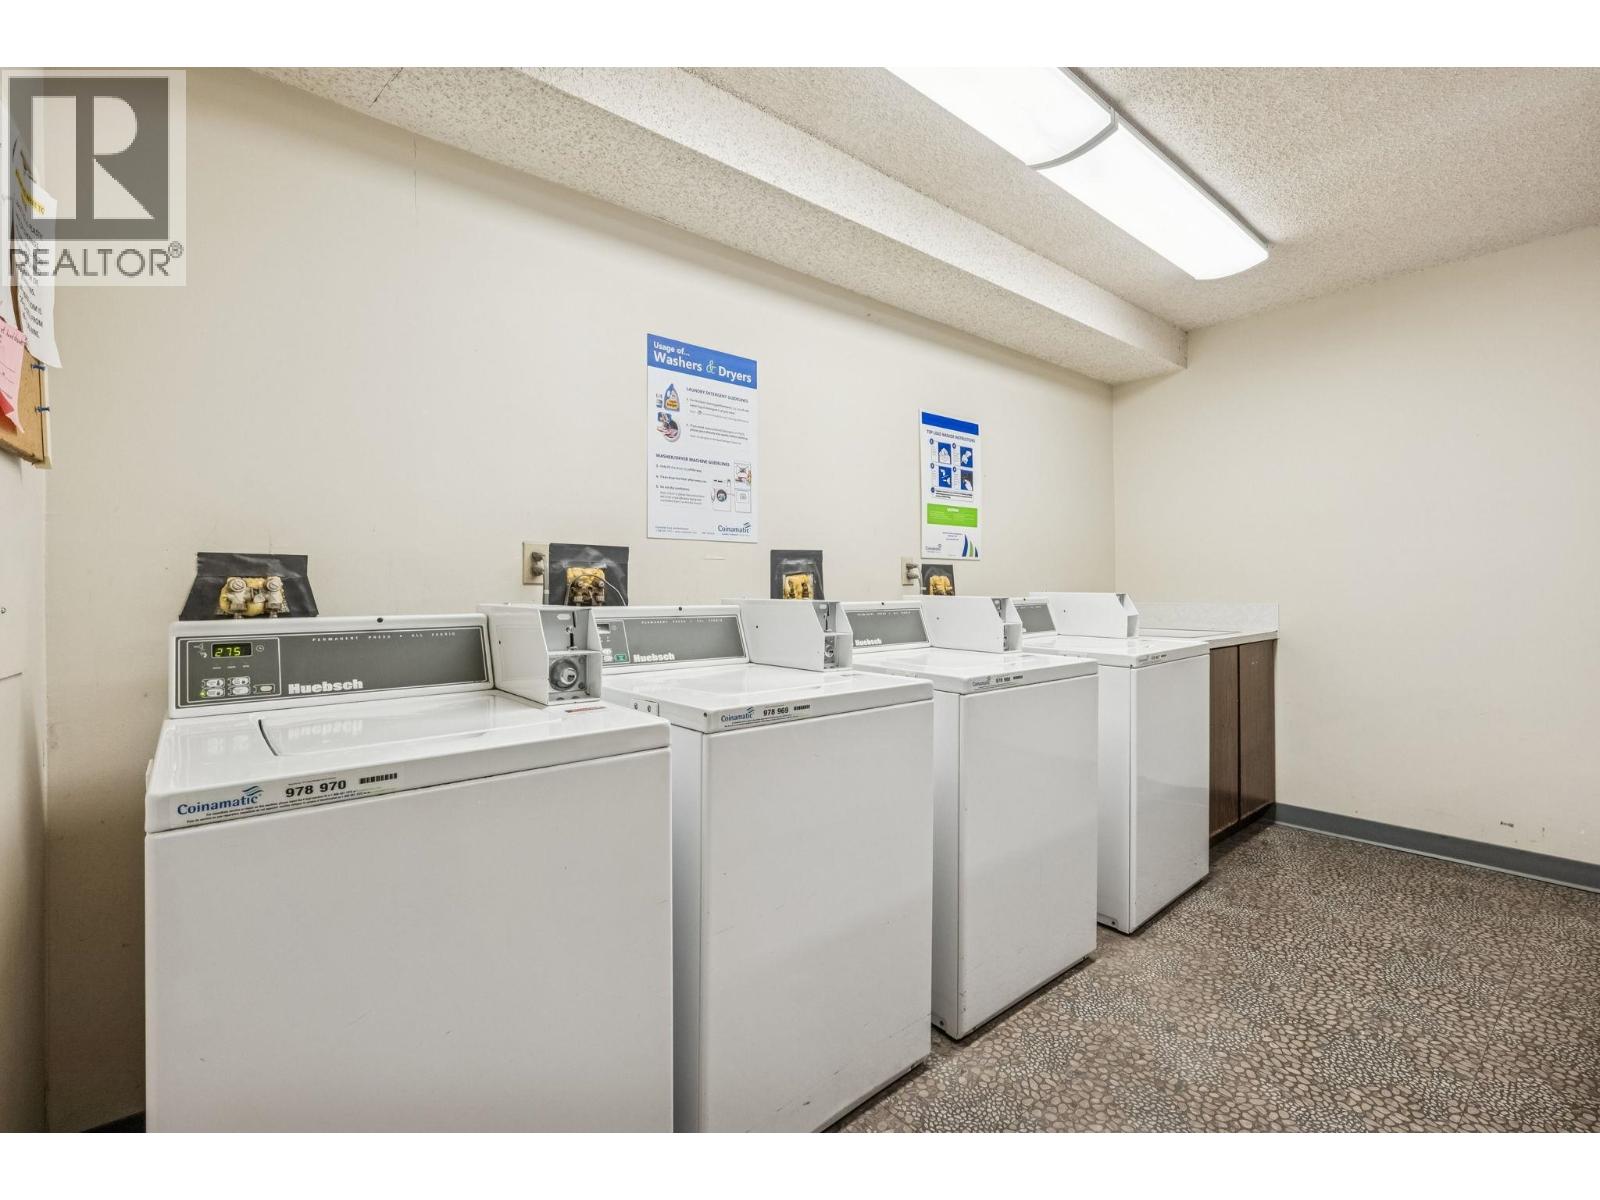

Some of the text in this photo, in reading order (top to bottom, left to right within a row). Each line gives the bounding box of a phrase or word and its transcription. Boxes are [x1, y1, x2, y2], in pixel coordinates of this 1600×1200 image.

[653, 341, 690, 357] Usage of...
[653, 350, 752, 383] Washers & Dryers
[686, 387, 705, 395] LAUNDRY
[717, 524, 749, 534] Coinamatic
[633, 651, 676, 663] Huebsch
[288, 678, 364, 695] Huebsch
[720, 712, 753, 722] Coinamatic
[763, 708, 775, 716] 978
[177, 793, 259, 816] Coinamatic
[285, 785, 313, 798] 978
[319, 779, 347, 793] 970
